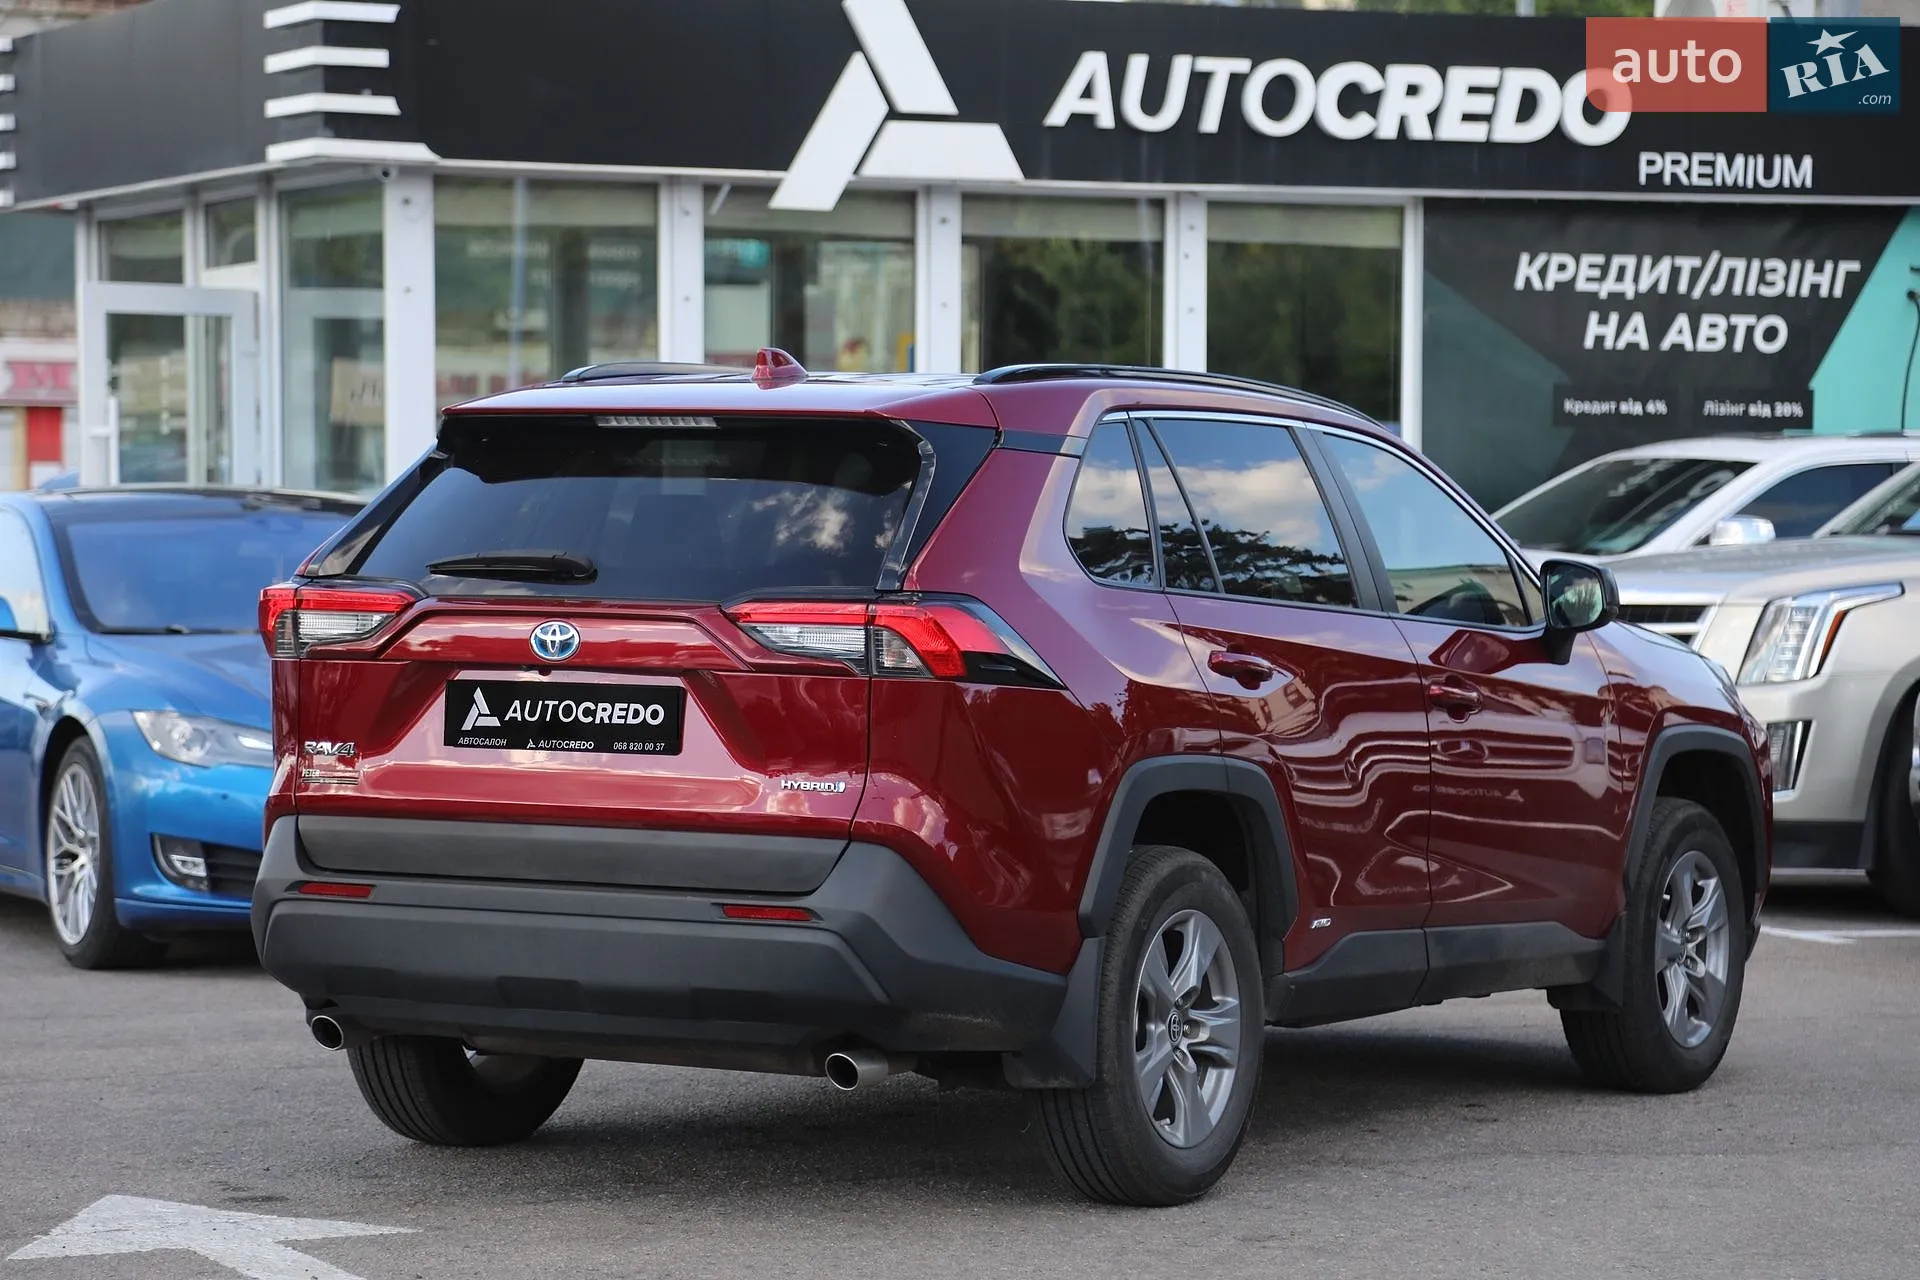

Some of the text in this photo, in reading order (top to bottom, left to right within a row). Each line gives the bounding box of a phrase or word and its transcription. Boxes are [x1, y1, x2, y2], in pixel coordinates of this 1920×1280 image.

[1042, 50, 1632, 147] AUTOCREDO
[1638, 151, 1814, 189] PREMIUM
[1514, 250, 1862, 300] КРЕДИТ/ЛІЗІНГ
[1583, 310, 1790, 354] НА АВТО
[1563, 398, 1617, 416] Кредит
[1645, 399, 1668, 416] 4%
[504, 699, 666, 726] AUTOCREDO
[304, 741, 355, 756] RAV4
[457, 736, 508, 747] АВТОСАЛОН
[538, 739, 595, 750] AUTOCREDO
[613, 741, 665, 751] 068 820 00 37
[780, 780, 834, 792] HYBRID
